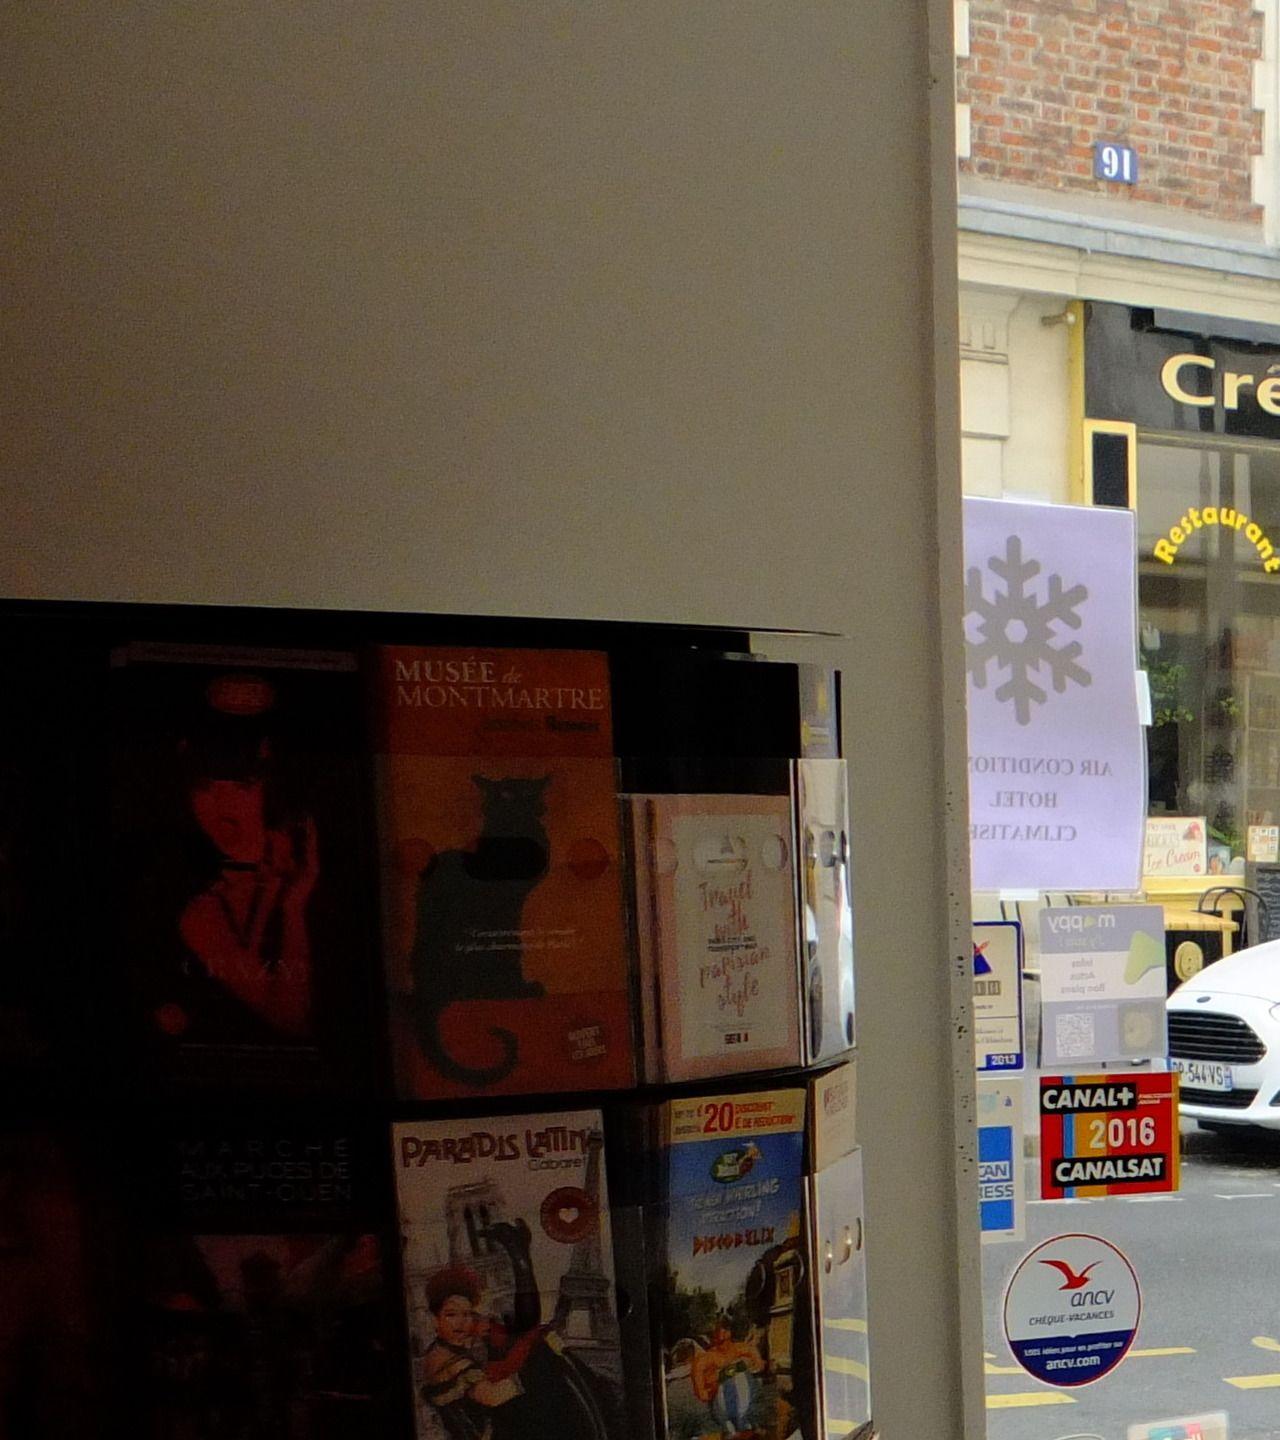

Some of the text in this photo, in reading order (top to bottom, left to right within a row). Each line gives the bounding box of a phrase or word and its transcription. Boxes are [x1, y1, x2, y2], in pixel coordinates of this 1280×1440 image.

[1101, 147, 1132, 178] 91
[395, 656, 497, 683] MUSÉE
[396, 685, 604, 710] MONTMARTRE
[1043, 1087, 1134, 1109] CANAL+
[704, 1102, 733, 1133] 20
[1090, 1117, 1155, 1148] 2016
[401, 1132, 521, 1167] PARADIS
[1056, 1158, 1163, 1181] CANALSAT
[1071, 1290, 1115, 1307] ancv
[1046, 1355, 1101, 1370] ancv.com
